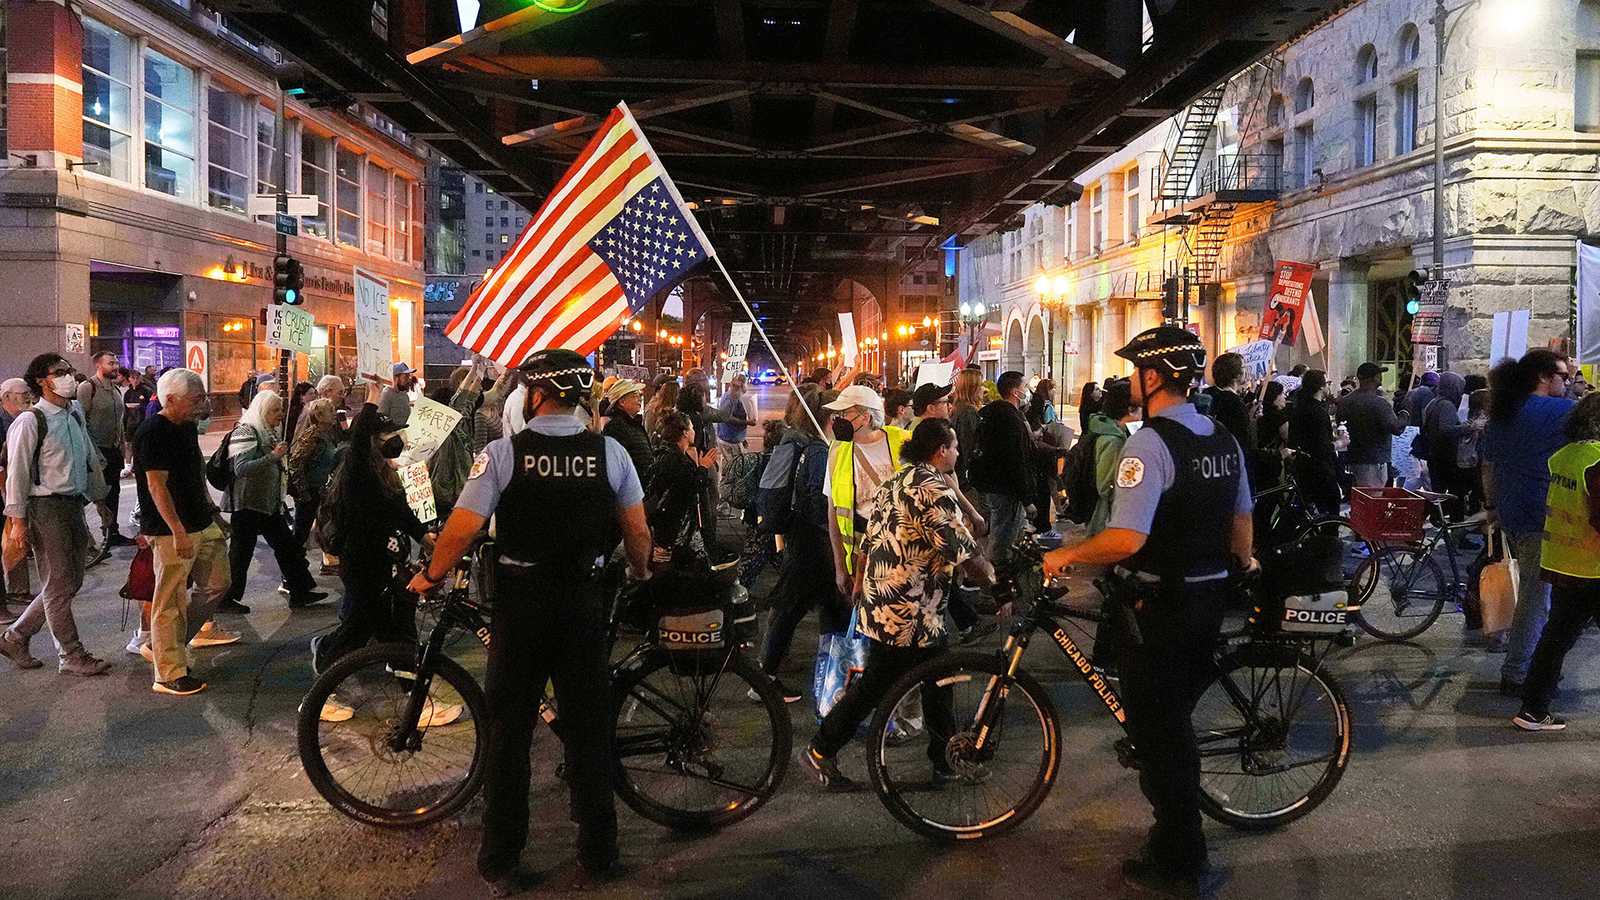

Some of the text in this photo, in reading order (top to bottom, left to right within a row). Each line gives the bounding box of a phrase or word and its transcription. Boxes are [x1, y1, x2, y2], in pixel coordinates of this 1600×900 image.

[1279, 270, 1293, 280] STOP
[1283, 287, 1302, 299] DEFEND
[1437, 281, 1450, 291] THE
[373, 285, 387, 316] ICE
[284, 310, 311, 334] CRUSH
[288, 328, 304, 347] ICE
[1427, 346, 1436, 354] ONE
[524, 455, 597, 478] POLICE
[1285, 609, 1347, 624] POLICE
[659, 630, 722, 644] POLICE
[1053, 627, 1121, 712] CHICAGO POLICE
